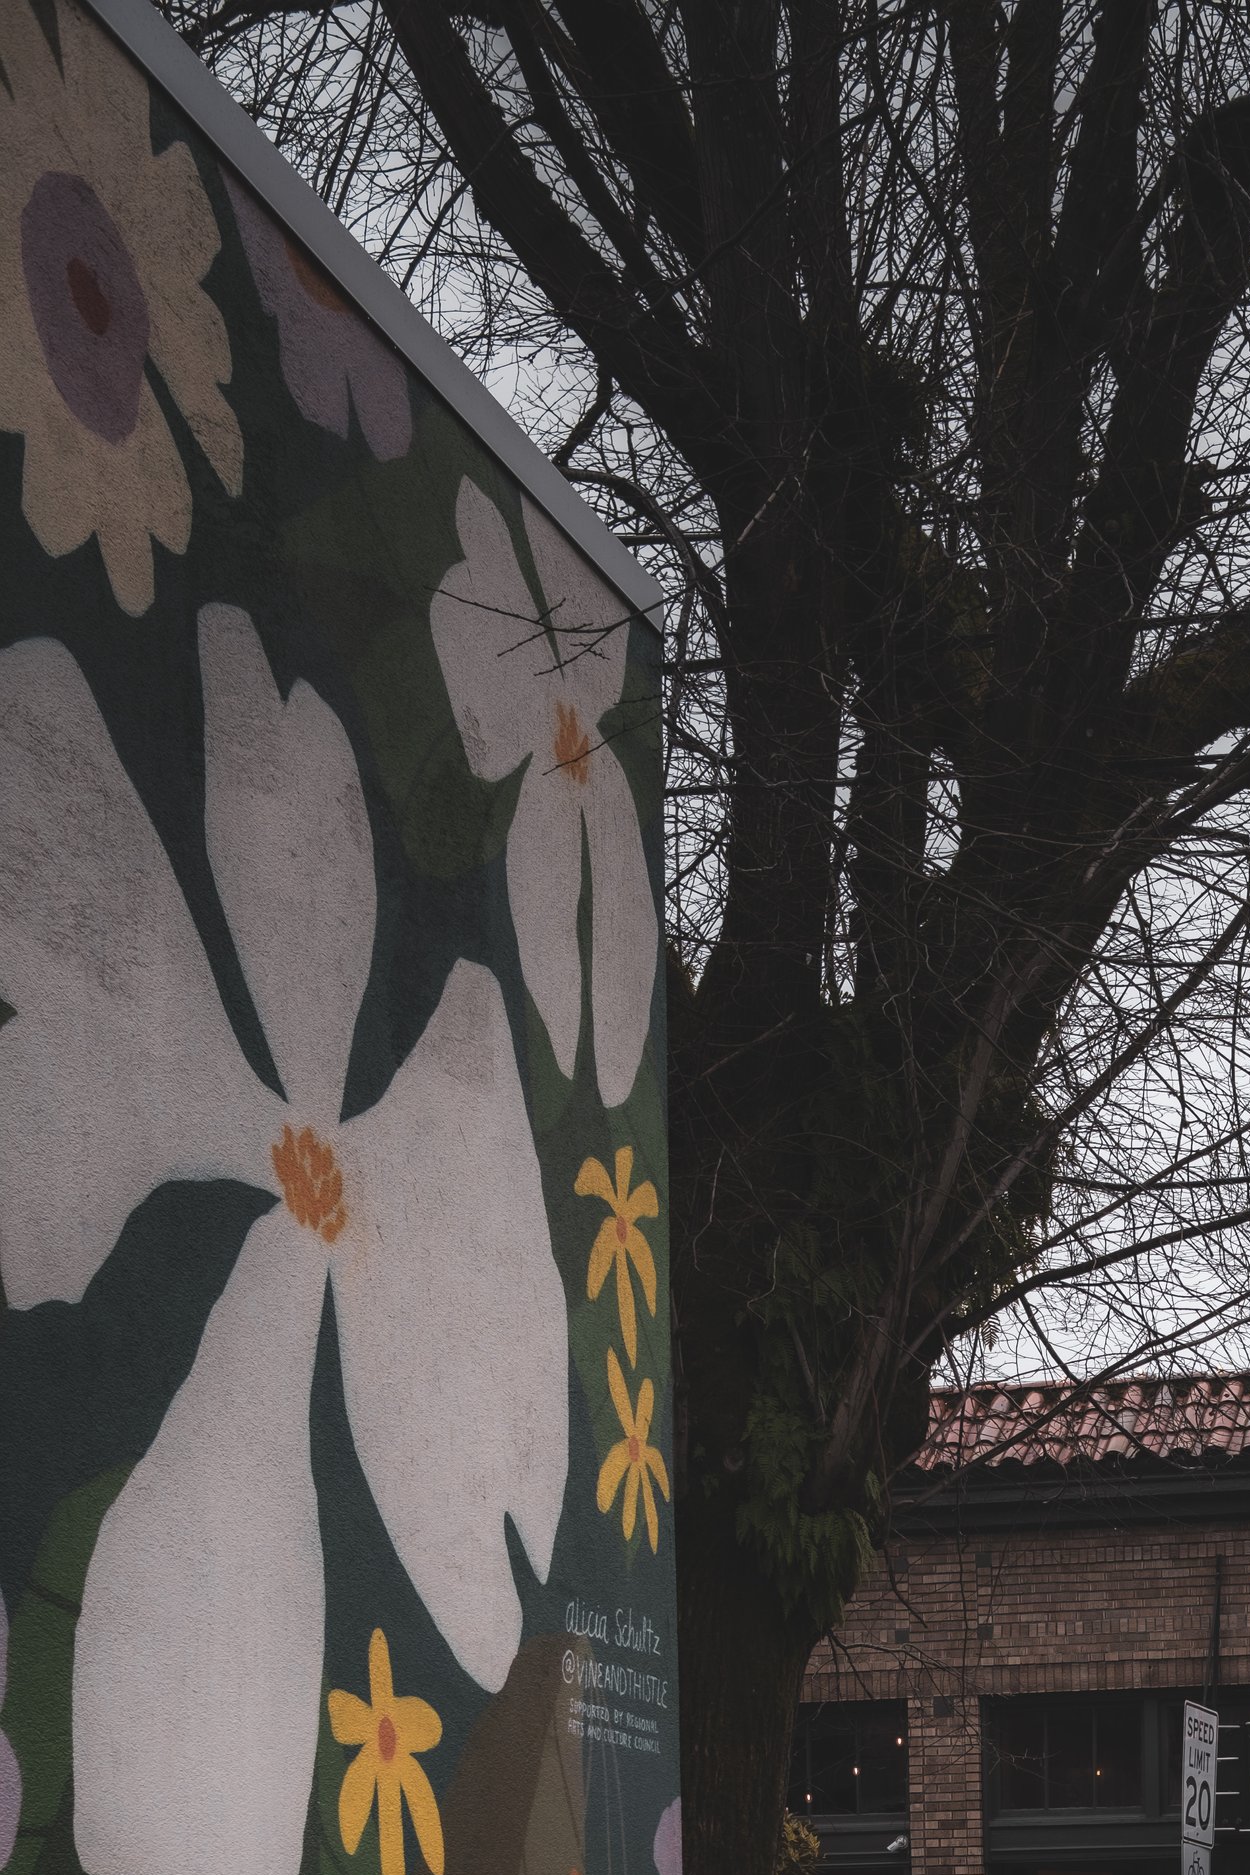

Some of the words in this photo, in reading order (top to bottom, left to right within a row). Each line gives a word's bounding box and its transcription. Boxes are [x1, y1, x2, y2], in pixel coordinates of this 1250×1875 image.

[615, 1607, 661, 1656] Schultz
[561, 1649, 668, 1709] @VINEANDTHISTLE
[569, 1697, 610, 1722] SUPPORTED
[614, 1708, 624, 1724] BY
[626, 1711, 659, 1734] REGIONAL
[1187, 1716, 1215, 1745] SPEED
[587, 1724, 601, 1741] AND
[603, 1728, 632, 1749] CULTURE
[1188, 1746, 1211, 1773] LIMIT
[1185, 1775, 1212, 1831] 20
